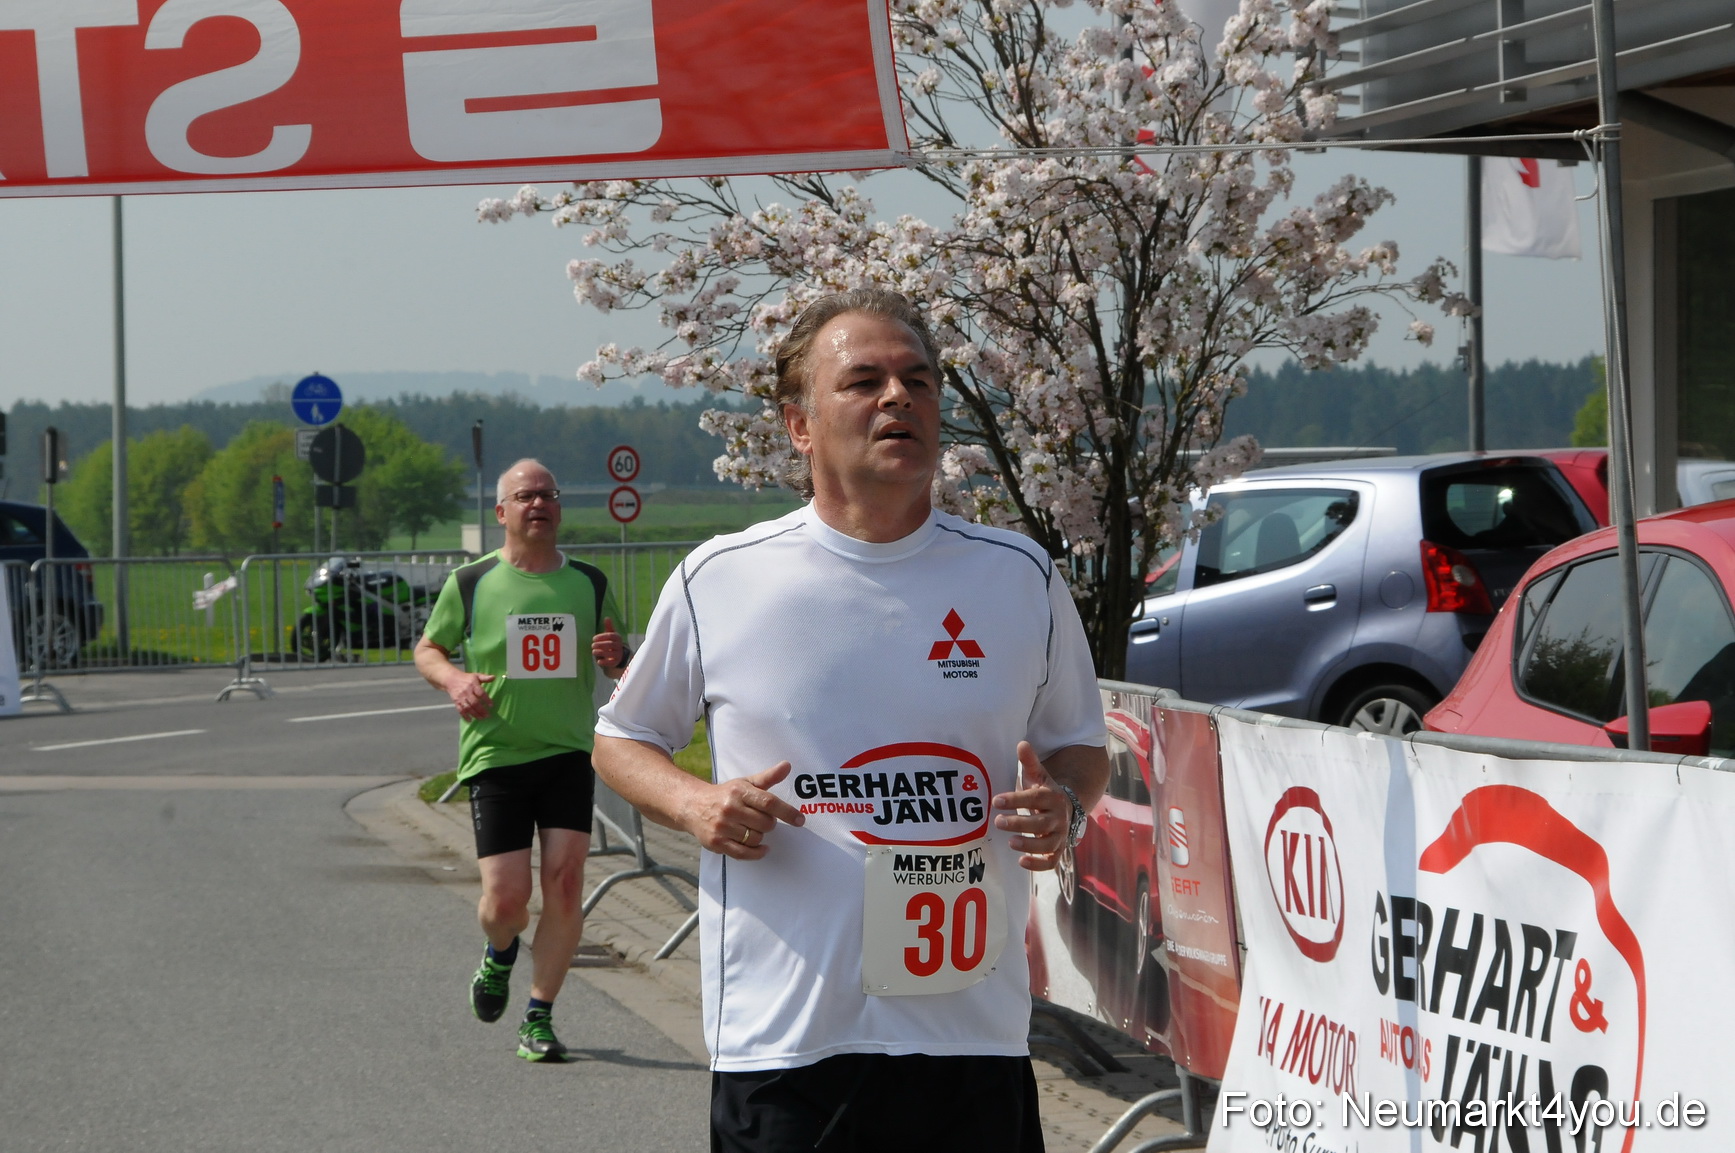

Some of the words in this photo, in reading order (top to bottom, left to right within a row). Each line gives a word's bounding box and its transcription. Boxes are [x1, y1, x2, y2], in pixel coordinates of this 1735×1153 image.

[614, 455, 634, 473] 60
[518, 617, 550, 625] MEYER
[522, 633, 561, 672] 69
[937, 659, 980, 668] MITSUBISHI
[943, 670, 978, 679] MOTORS
[794, 770, 958, 800] GERHART
[961, 774, 979, 792] &
[799, 802, 875, 815] AUTOHAUS
[872, 796, 984, 825] JÄNIG
[893, 852, 965, 872] MEYER
[893, 871, 965, 885] WERBUNG
[1281, 830, 1336, 924] KIA
[903, 887, 988, 977] 30
[1371, 889, 1578, 1044] GERHART
[1569, 957, 1609, 1035] &
